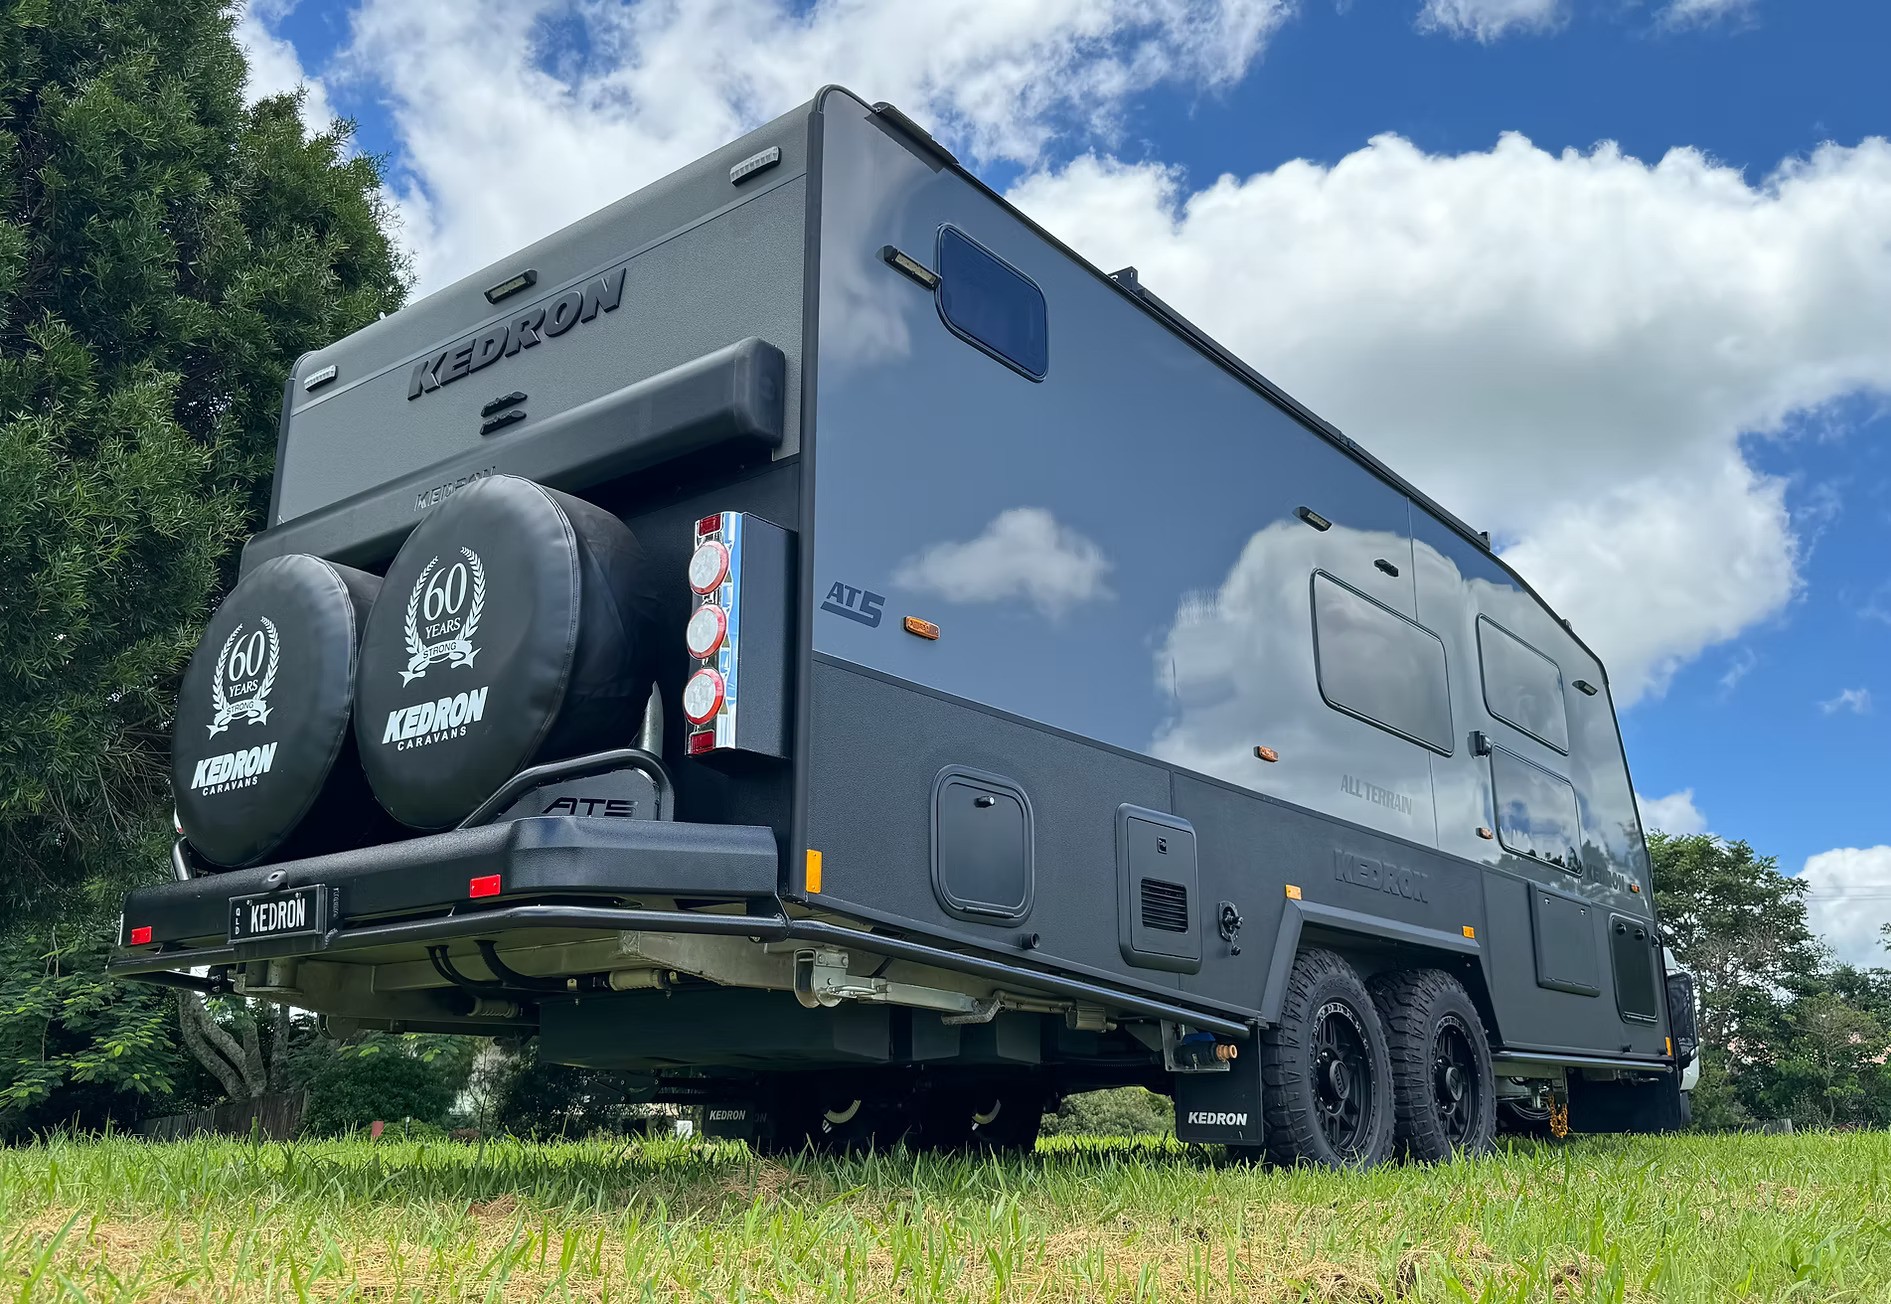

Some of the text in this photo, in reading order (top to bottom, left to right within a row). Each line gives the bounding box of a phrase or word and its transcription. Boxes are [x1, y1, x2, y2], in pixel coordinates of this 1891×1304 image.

[407, 267, 627, 401] KEDRON
[423, 562, 468, 621] 60
[820, 580, 886, 629] AT5
[425, 617, 461, 640] YEARS
[228, 630, 265, 682] 60
[422, 641, 457, 660] STRONG
[229, 679, 259, 698] YEARS
[226, 700, 254, 716] STRONG
[381, 686, 489, 745] KEDRON
[397, 726, 467, 751] CARAVANS
[190, 742, 278, 790] KEDRON
[202, 776, 258, 796] CARAVANS
[1340, 774, 1412, 816] ALL TERRAIN
[1333, 850, 1429, 904] KEDRON
[250, 898, 306, 933] KEDRON
[709, 1109, 746, 1121] KEDRON
[1187, 1111, 1248, 1126] KEDRON
